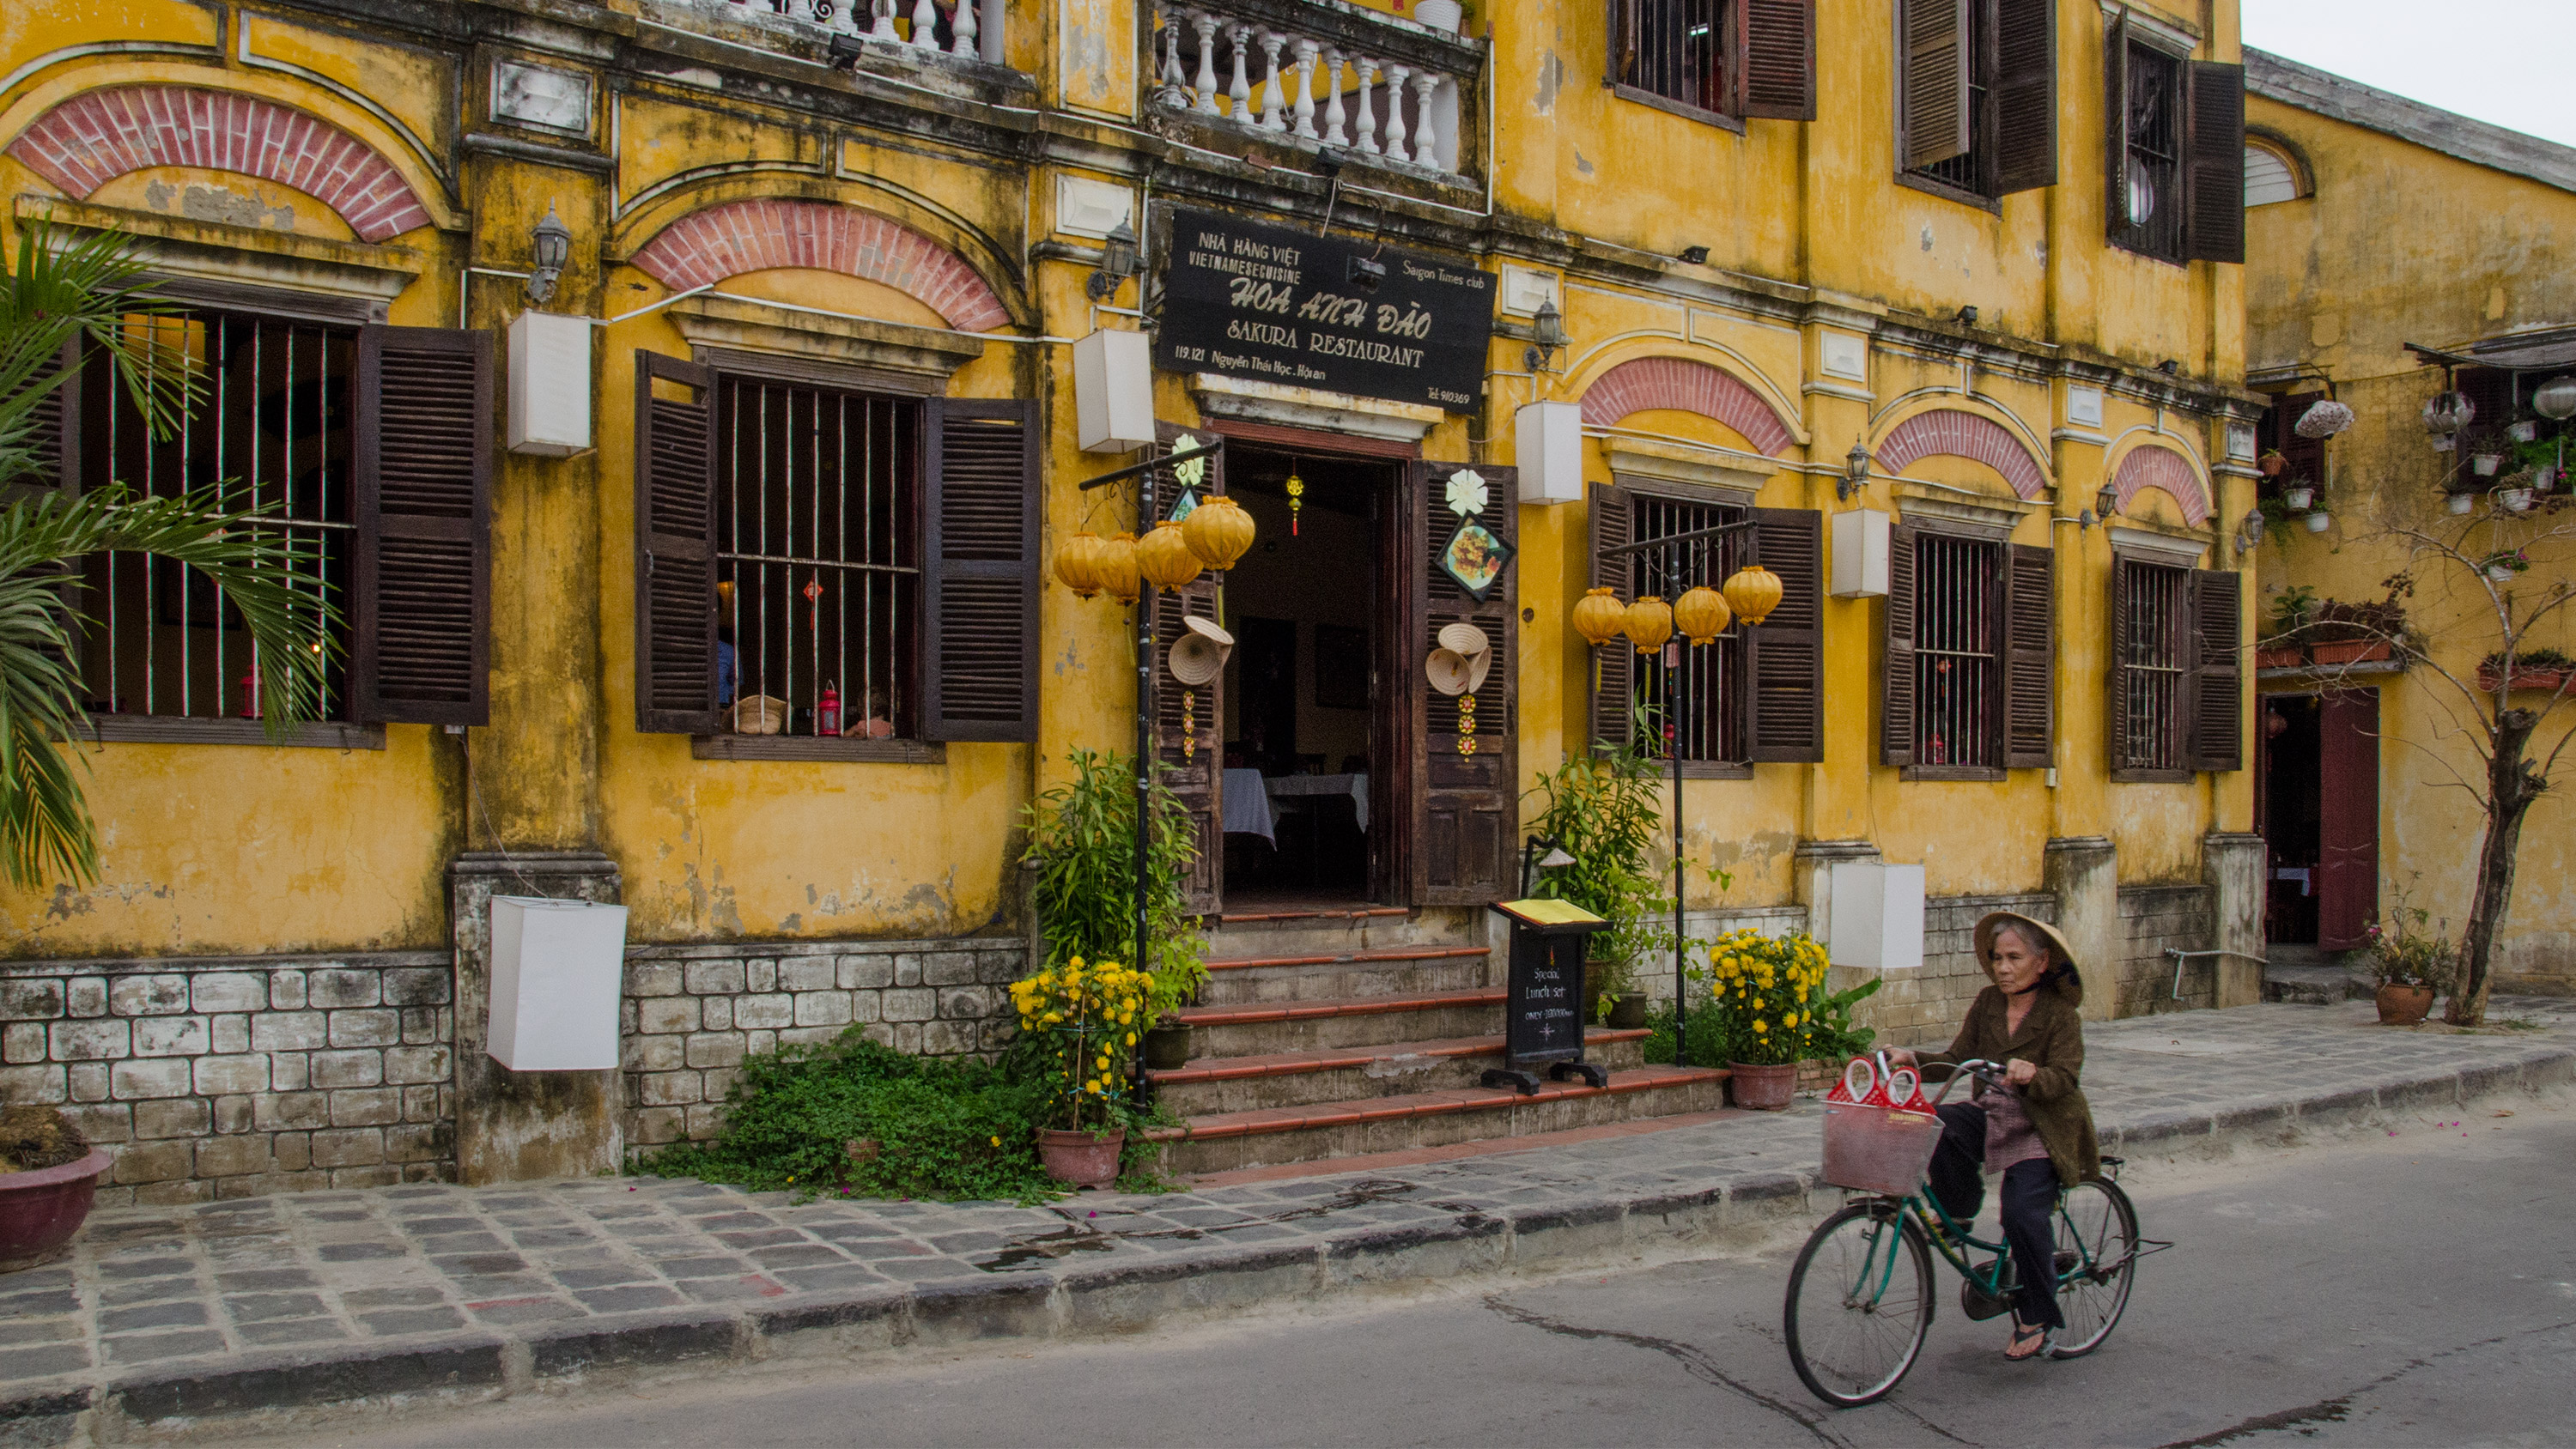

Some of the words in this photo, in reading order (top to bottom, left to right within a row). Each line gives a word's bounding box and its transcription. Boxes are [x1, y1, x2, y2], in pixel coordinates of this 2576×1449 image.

[1233, 238, 1269, 260] HÀNG
[1273, 246, 1301, 267] VIỆT
[1402, 259, 1436, 282] Saigon
[1437, 268, 1463, 285] Times
[1466, 276, 1485, 289] club
[1230, 277, 1292, 314] HOA
[1297, 292, 1369, 328] ANH
[1376, 300, 1431, 339] ĐÀO
[1175, 345, 1205, 361] 119.121
[1227, 319, 1297, 349] SAKURA
[1309, 332, 1425, 368] RESTAURANT
[1440, 390, 1470, 404] 910369
[1526, 985, 1550, 999] Lunch
[1553, 986, 1567, 998] set
